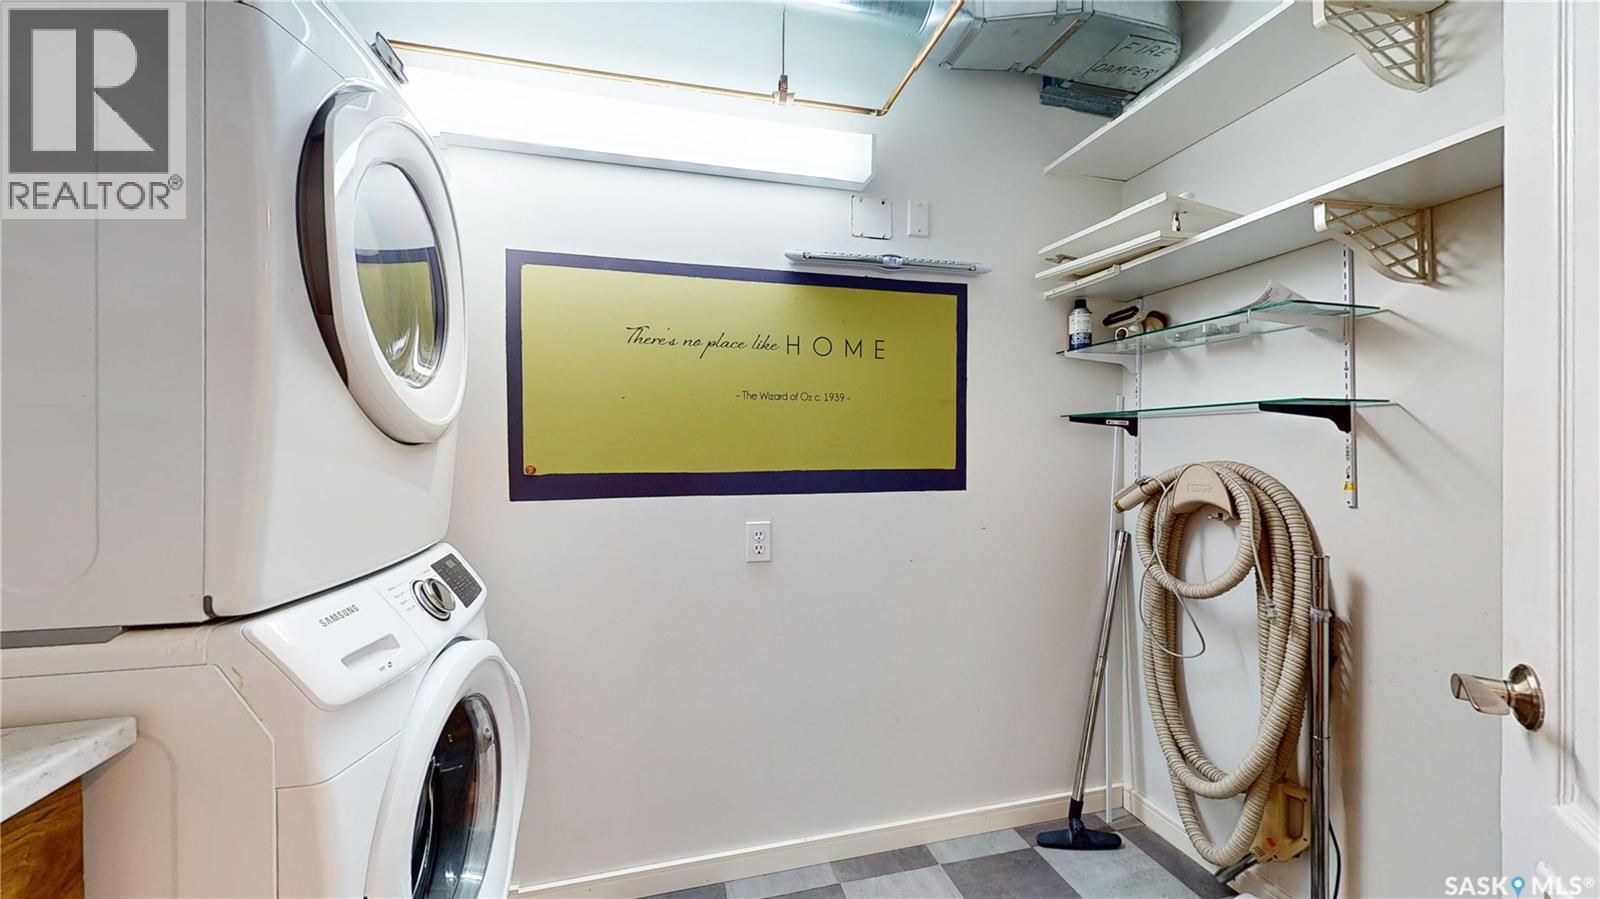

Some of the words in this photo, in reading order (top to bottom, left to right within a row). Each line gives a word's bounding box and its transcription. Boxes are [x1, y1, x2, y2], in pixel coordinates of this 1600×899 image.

[1118, 40, 1173, 58] FIRE
[1092, 62, 1153, 79] DAMPER
[626, 325, 678, 346] There's
[682, 338, 703, 346] no
[699, 332, 748, 360] place
[751, 334, 780, 351] like
[742, 390, 757, 400] The
[760, 391, 788, 401] Wizard
[790, 392, 798, 401] of
[800, 392, 812, 402] Oz
[824, 393, 845, 402] 1939
[319, 603, 360, 628] SAMSUNG
